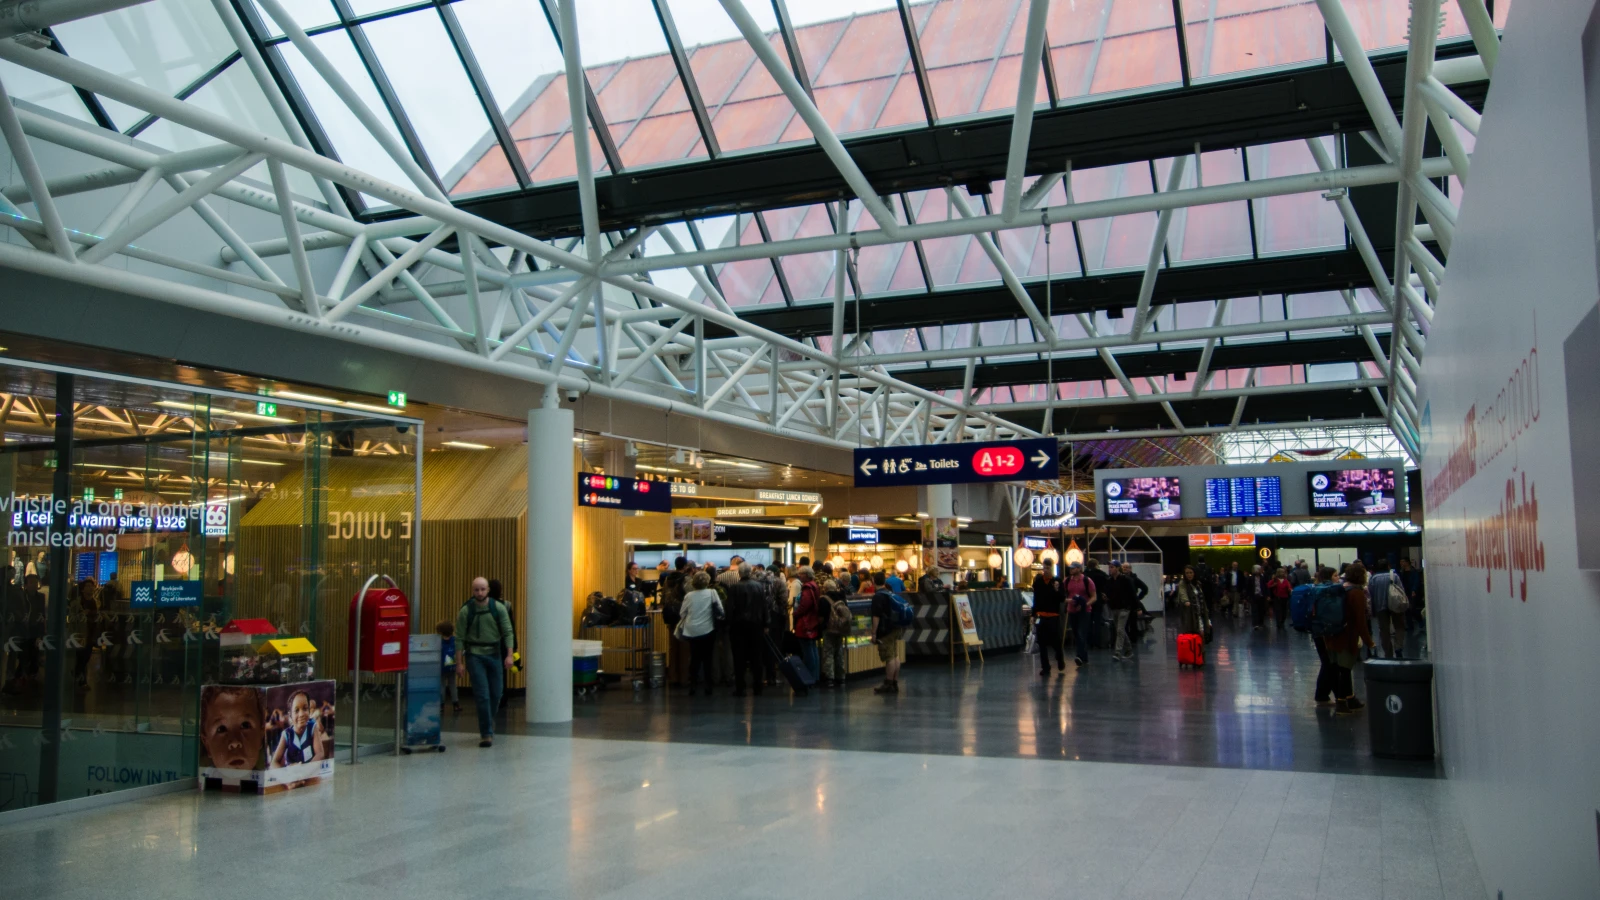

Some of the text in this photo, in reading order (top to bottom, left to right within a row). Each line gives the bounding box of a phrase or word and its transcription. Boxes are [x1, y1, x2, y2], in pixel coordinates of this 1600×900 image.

[1508, 308, 1541, 473] good
[930, 458, 959, 469] Toilets
[981, 452, 1014, 467] A 1-2
[679, 485, 686, 493] TO
[688, 485, 695, 494] GO
[759, 491, 818, 502] BREAKFAST LUNCH DINNER
[73, 498, 92, 515] at
[99, 502, 133, 517] one
[139, 501, 207, 520] another
[26, 510, 76, 526] Iceld
[80, 515, 116, 526] warm
[120, 515, 152, 528] since
[156, 515, 187, 529] 1926
[1505, 469, 1546, 602] flight.
[87, 765, 143, 784] FOLLOW
[147, 769, 161, 785] IN
